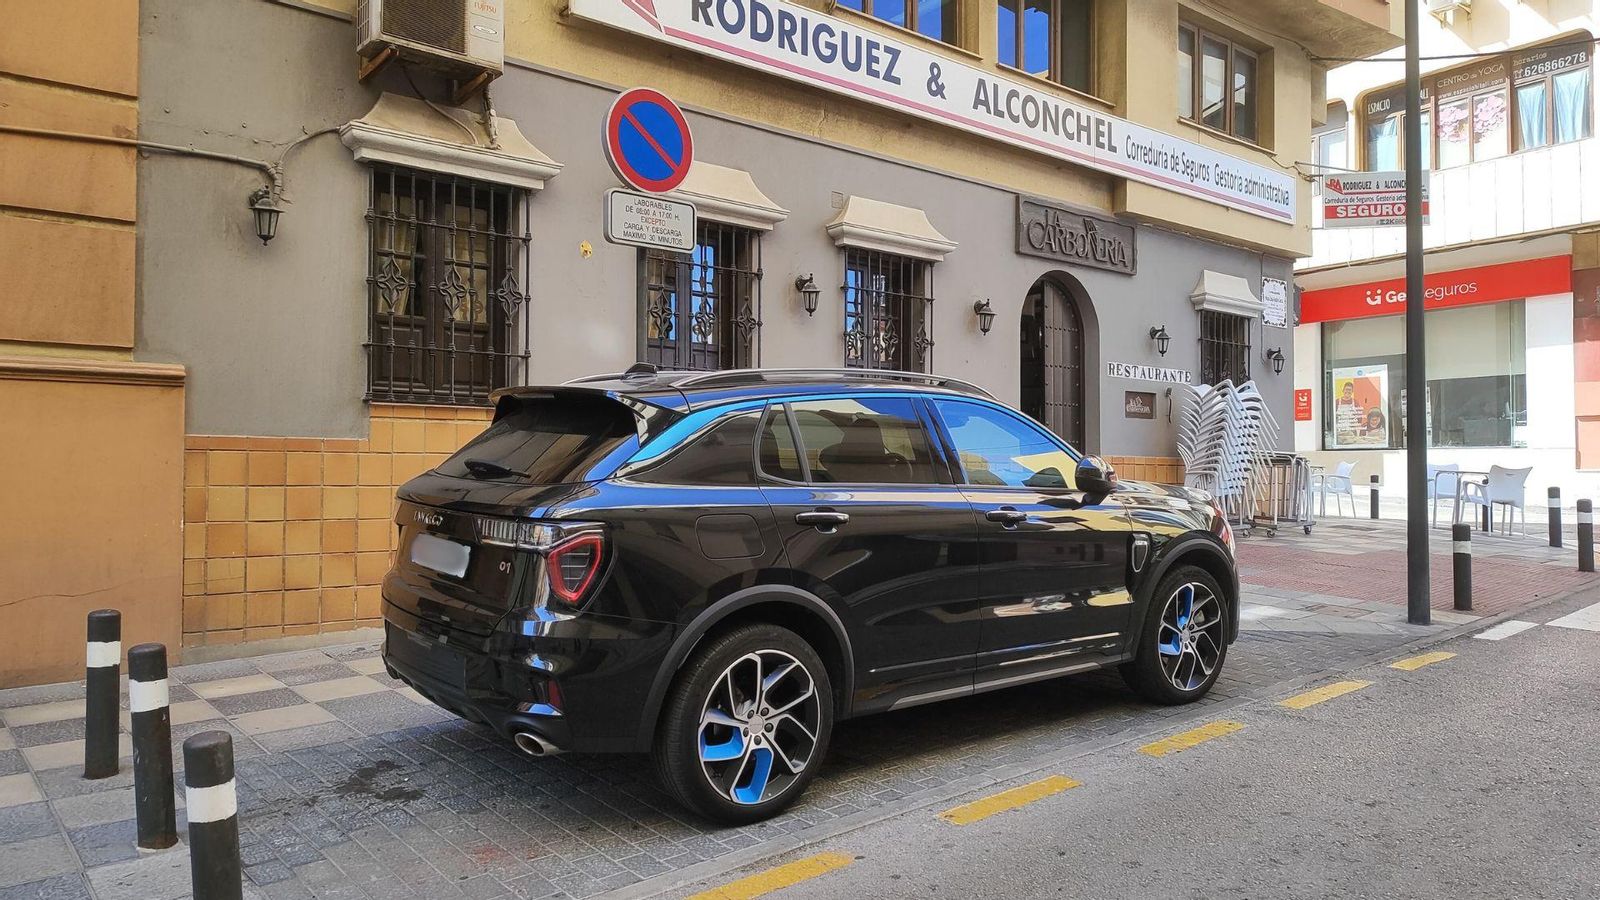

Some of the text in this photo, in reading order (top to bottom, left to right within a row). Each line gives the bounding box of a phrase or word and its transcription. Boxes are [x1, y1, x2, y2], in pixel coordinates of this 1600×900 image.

[1437, 73, 1470, 88] CENTRO
[1478, 63, 1505, 76] YOGA
[691, 0, 902, 86] RODRIGUEZ
[926, 61, 947, 100] &
[972, 78, 1118, 154] ALCONCHEL
[1125, 134, 1169, 170] Correduría
[1170, 152, 1180, 174] de
[1181, 151, 1210, 183] Seguros
[1244, 174, 1290, 206] administrativa
[1367, 98, 1391, 115] ESPACIO
[1343, 180, 1372, 190] RODRIGUEZ
[1375, 180, 1380, 189] &
[625, 205, 634, 213] DE
[634, 198, 673, 212] LABORABLES
[1336, 203, 1408, 218] SEGURO
[640, 216, 666, 226] EXCEPTO
[623, 221, 644, 232] CARGA
[651, 226, 683, 238] DESCARGA
[649, 234, 656, 242] 30
[657, 236, 684, 246] MINUTOS
[1108, 362, 1192, 383] RESTAURANTE
[499, 561, 511, 574] 01
